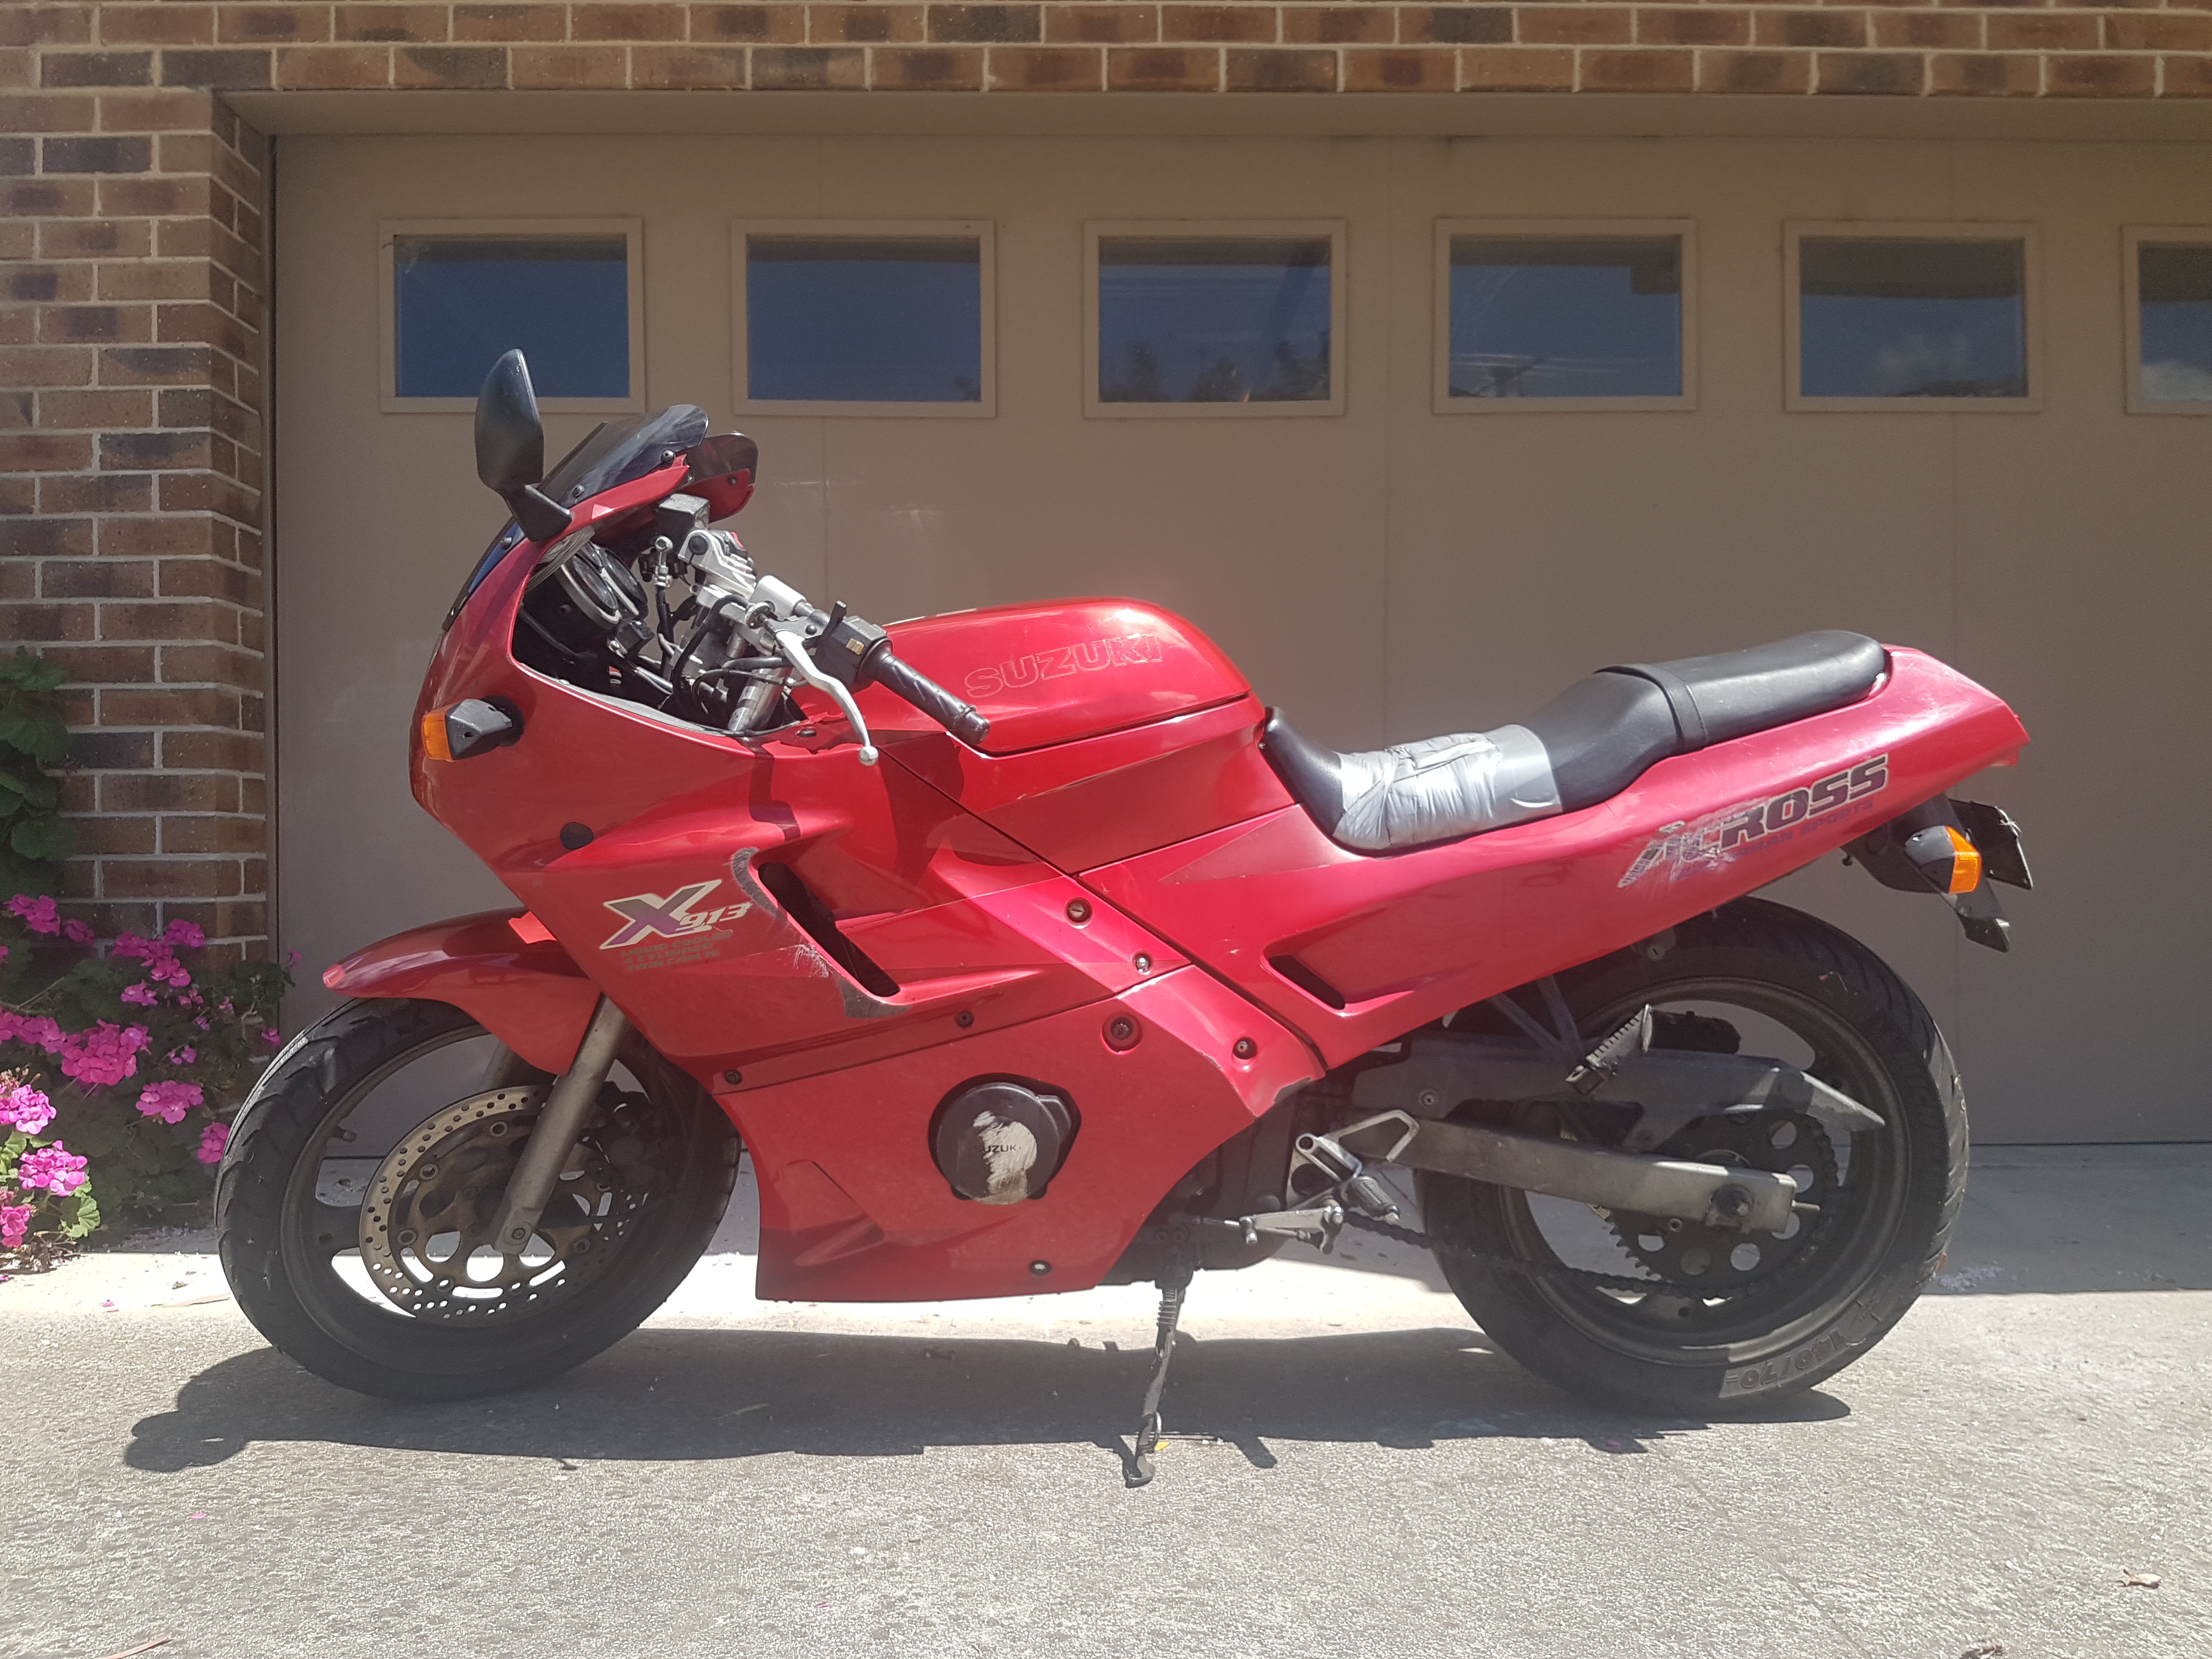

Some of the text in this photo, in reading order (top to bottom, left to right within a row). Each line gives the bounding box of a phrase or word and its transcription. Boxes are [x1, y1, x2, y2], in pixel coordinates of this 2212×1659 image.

[964, 634, 1163, 699] SUZUKI
[621, 930, 732, 957] LIQUID COOLED
[637, 943, 713, 962] CYLINDER
[627, 960, 664, 970] TWIN
[667, 953, 701, 965] CAM
